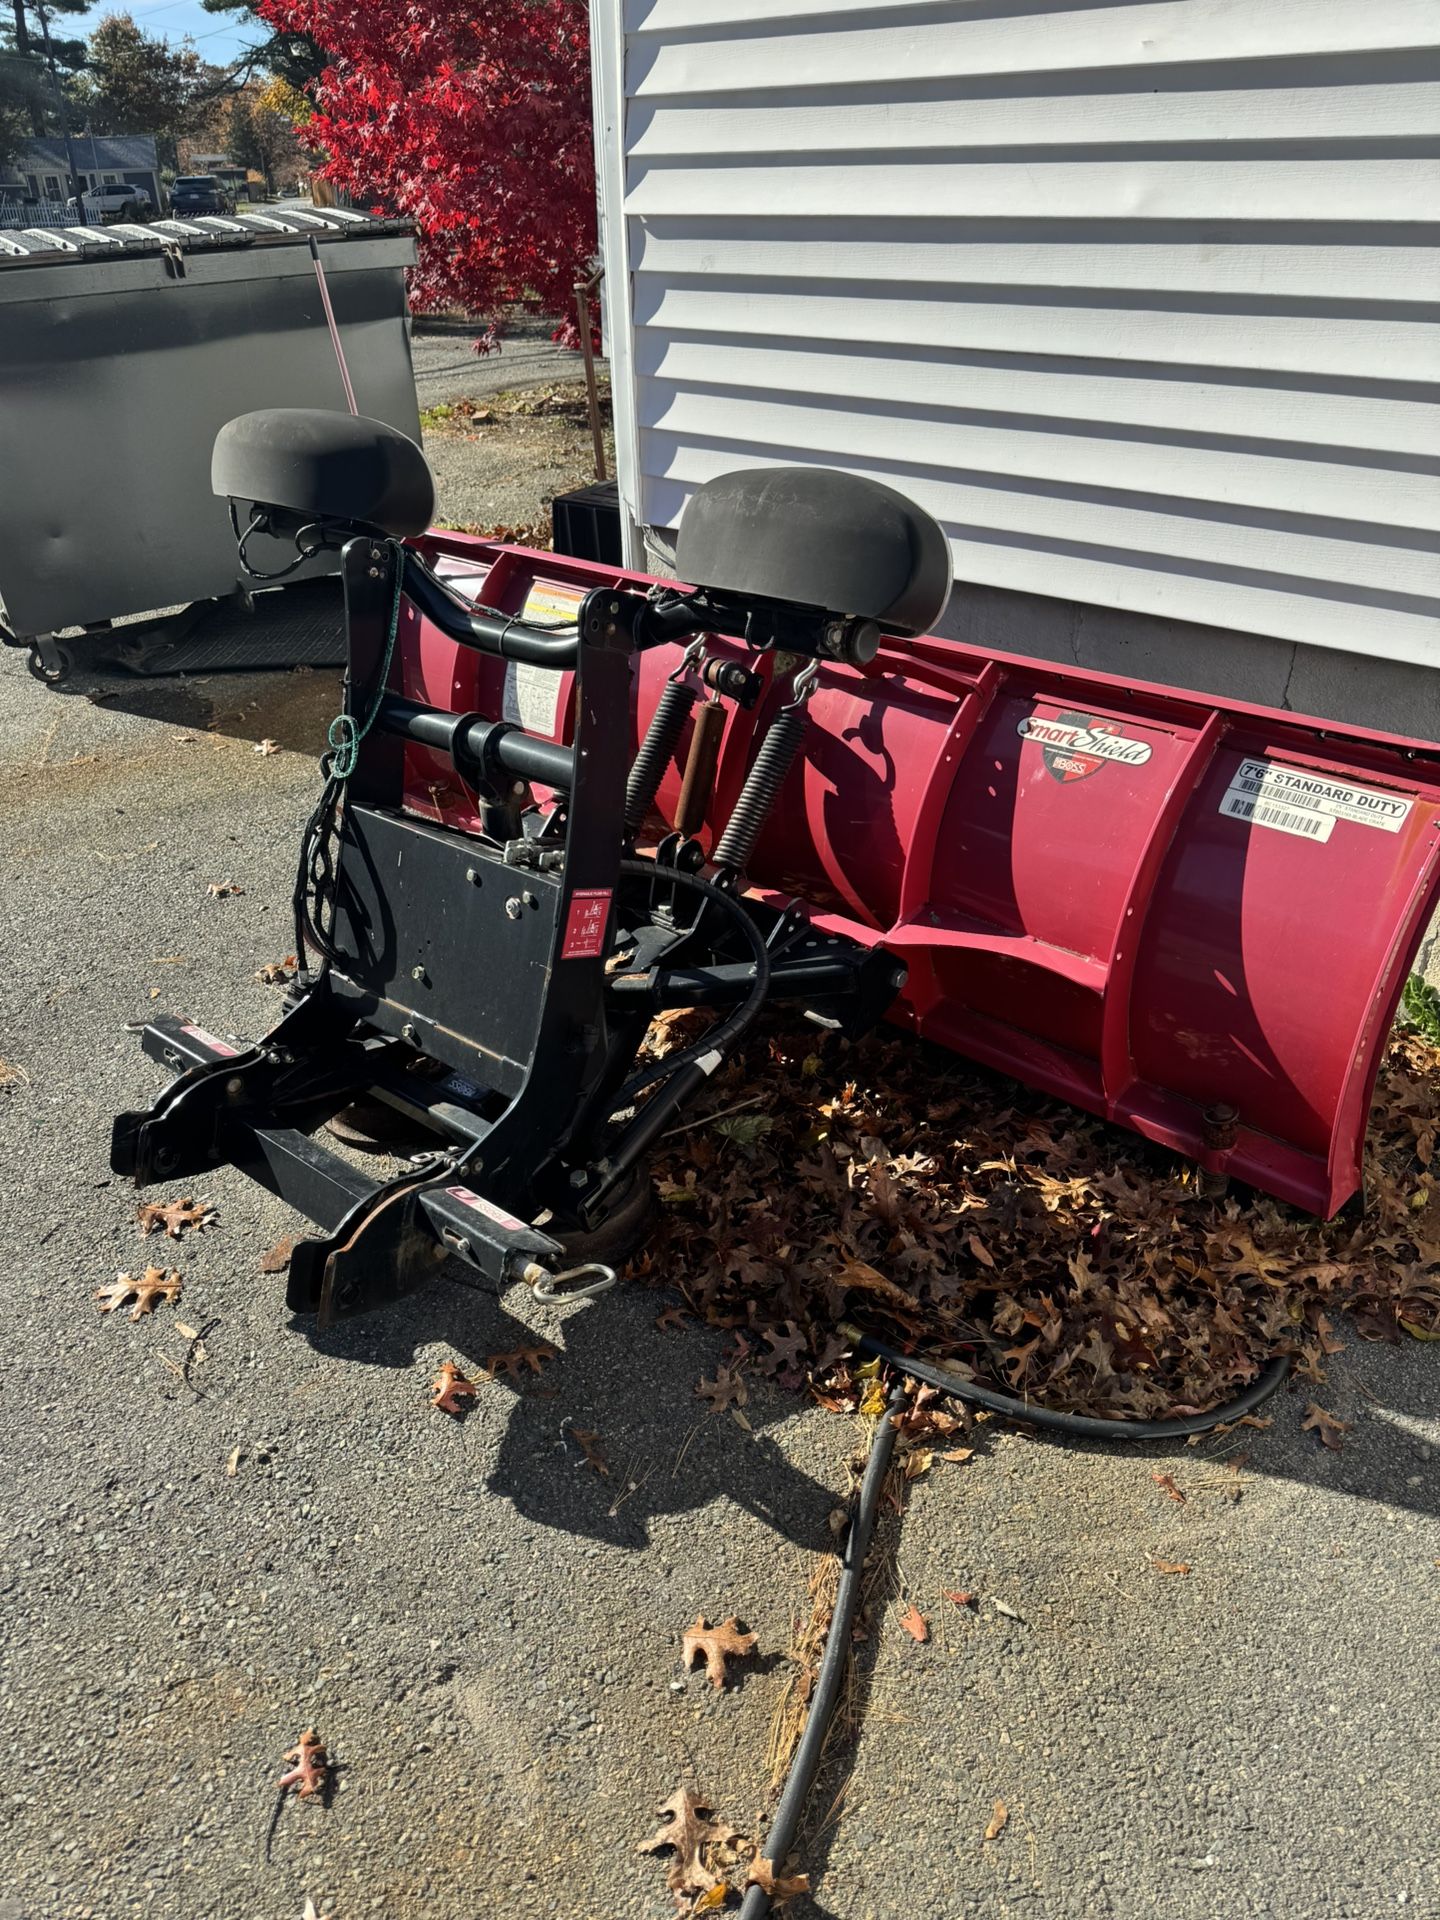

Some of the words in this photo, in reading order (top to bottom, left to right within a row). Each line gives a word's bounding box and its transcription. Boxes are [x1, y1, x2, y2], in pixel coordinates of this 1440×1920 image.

[1059, 759, 1086, 775] BOSS
[1274, 774, 1354, 802] STANDARD
[1357, 796, 1402, 815] DUTY
